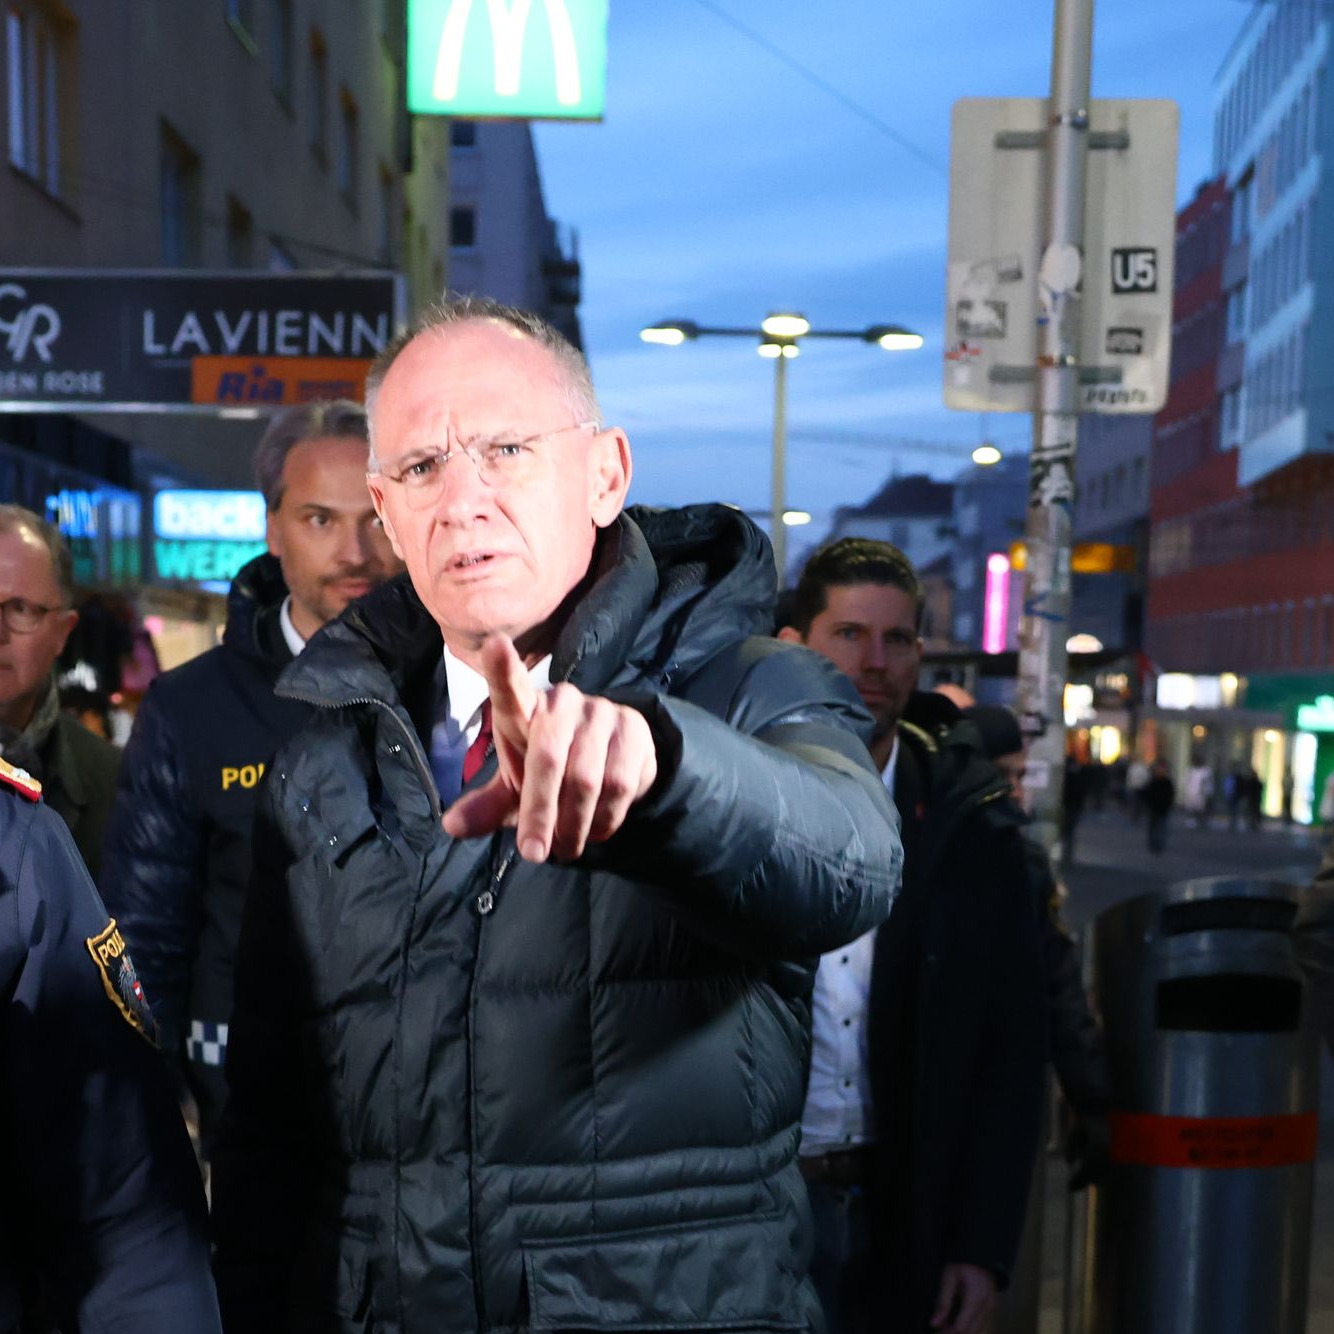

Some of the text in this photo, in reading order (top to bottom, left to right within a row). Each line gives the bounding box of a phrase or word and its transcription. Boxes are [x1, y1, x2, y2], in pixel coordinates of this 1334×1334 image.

[1114, 252, 1156, 289] U5
[42, 369, 105, 395] ROSE
[160, 494, 264, 537] back
